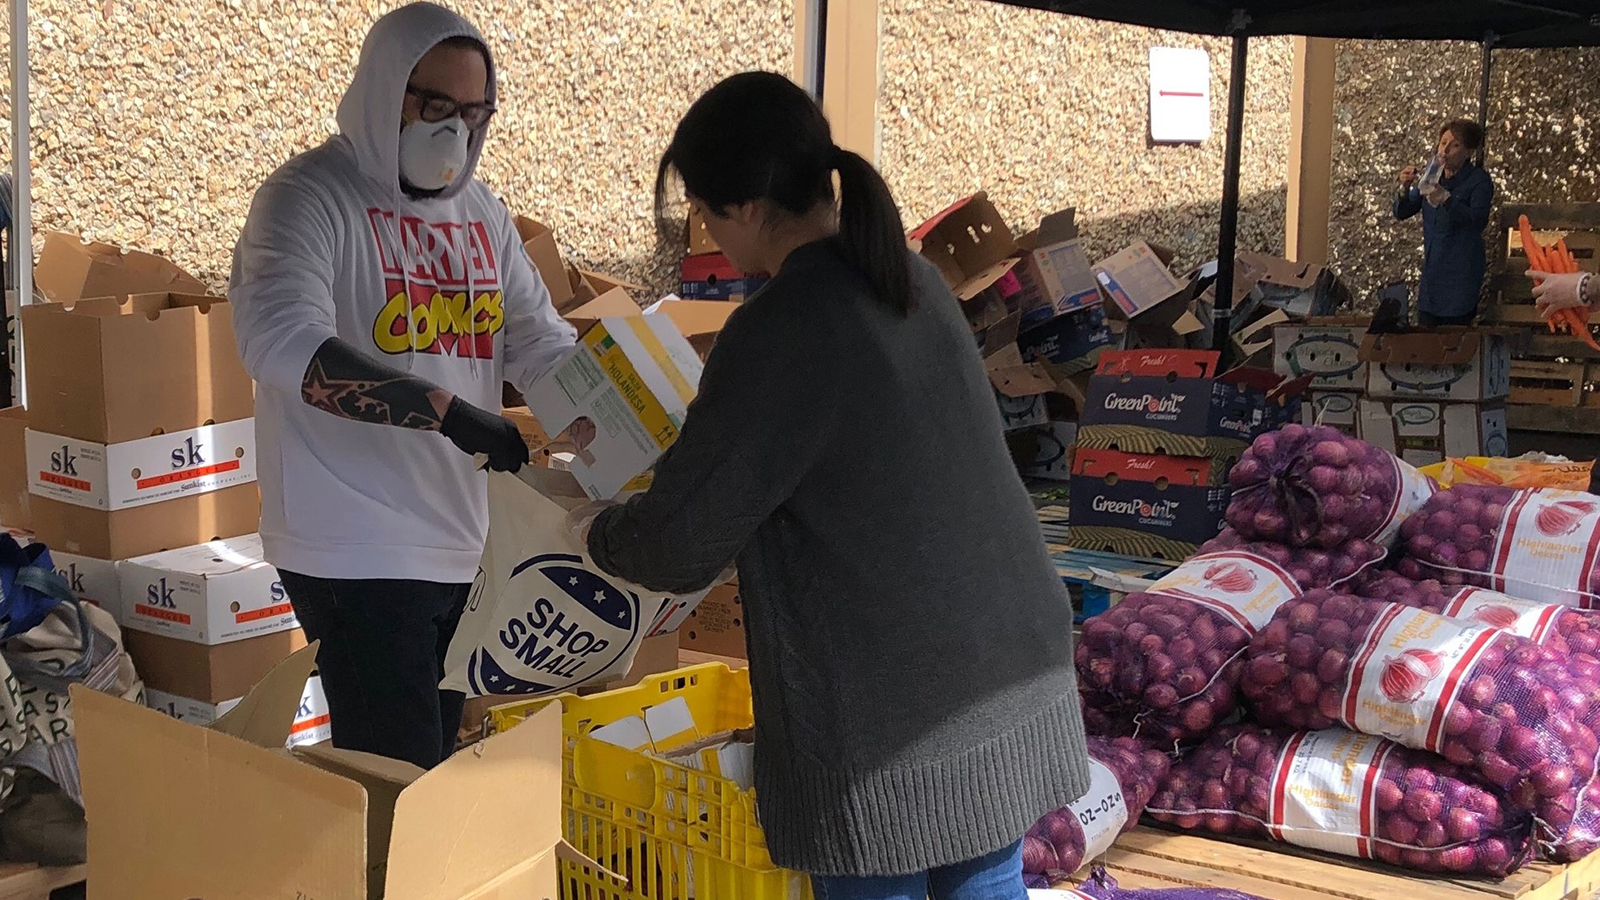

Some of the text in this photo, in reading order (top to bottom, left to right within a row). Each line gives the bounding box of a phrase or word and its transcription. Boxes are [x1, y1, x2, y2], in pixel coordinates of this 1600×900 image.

[370, 209, 497, 283] MARVEL
[373, 290, 505, 354] COMICS
[1140, 354, 1167, 367] Fresh!
[608, 363, 645, 414] HOLANDESA
[1104, 391, 1184, 414] GreenPoint
[51, 445, 79, 477] sk
[171, 436, 206, 470] sk
[1125, 457, 1155, 470] Fresh!
[1092, 494, 1179, 519] GreenPoint
[1517, 537, 1584, 554] Highlander
[147, 577, 177, 610] sk
[526, 598, 610, 658] SHOP
[499, 618, 587, 679] SMALL
